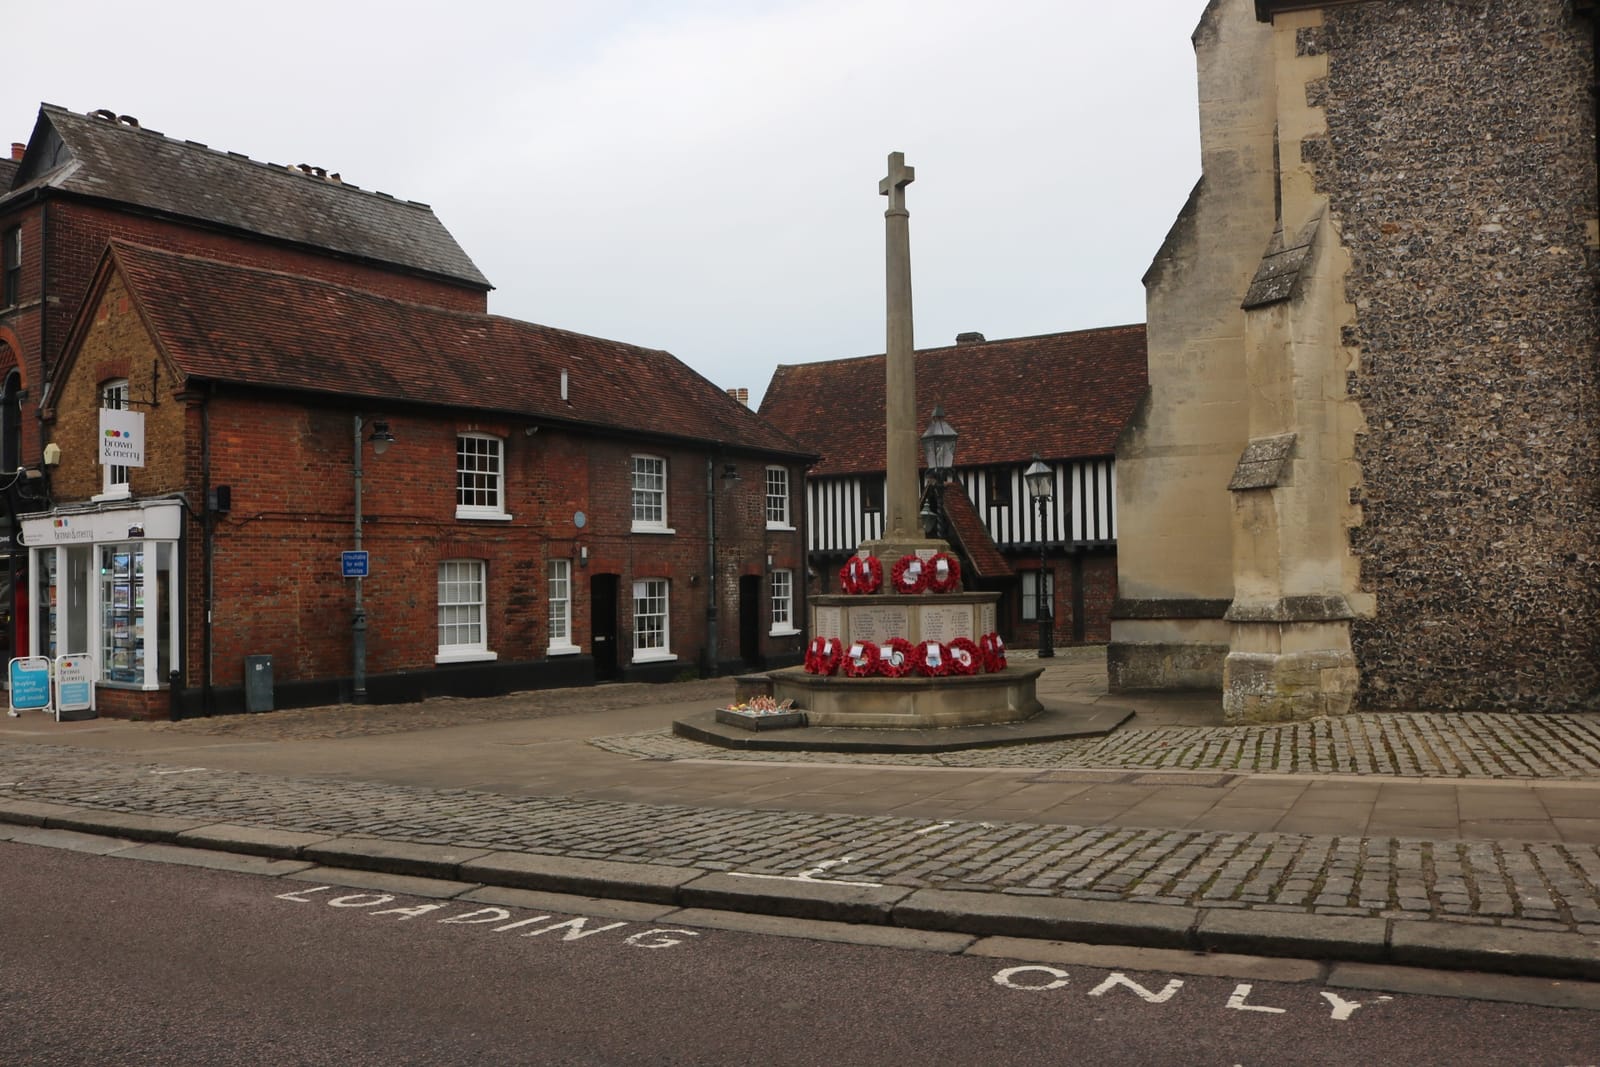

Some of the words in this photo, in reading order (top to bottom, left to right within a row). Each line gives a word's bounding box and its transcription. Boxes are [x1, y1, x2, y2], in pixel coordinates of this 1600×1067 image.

[104, 437, 133, 449] brown
[104, 447, 111, 457] &
[113, 450, 140, 462] merry
[274, 886, 699, 949] LOADING
[991, 965, 1394, 1021] ONLY
